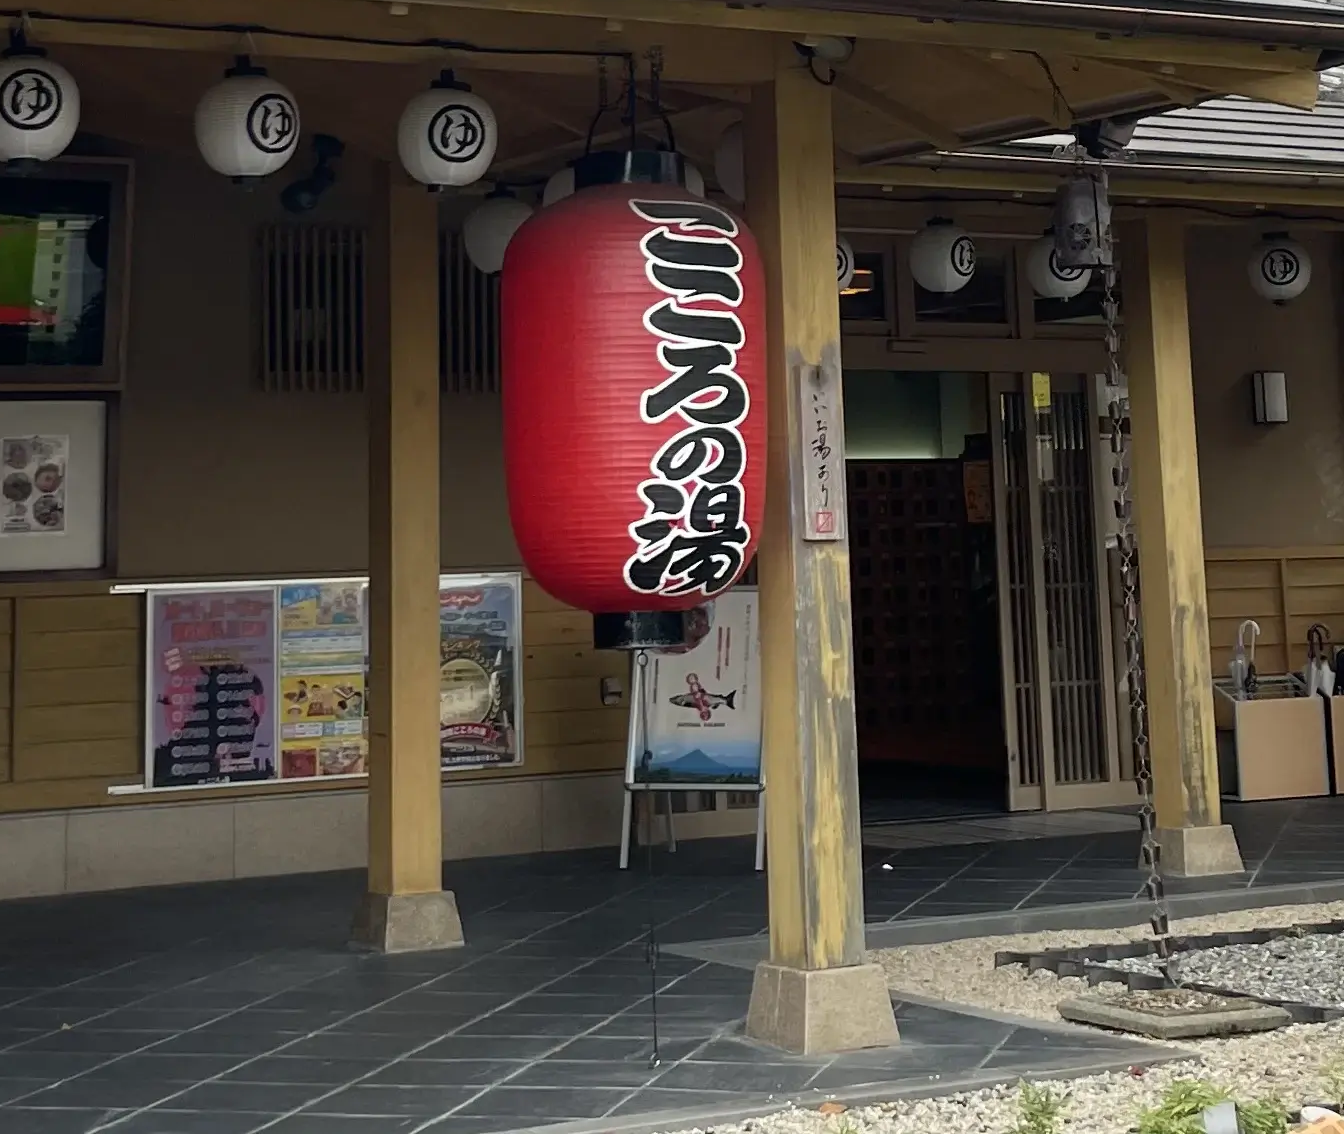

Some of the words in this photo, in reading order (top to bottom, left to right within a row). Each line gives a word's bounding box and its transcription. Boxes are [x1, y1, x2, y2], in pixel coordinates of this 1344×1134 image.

[624, 197, 751, 597] こころの湯
